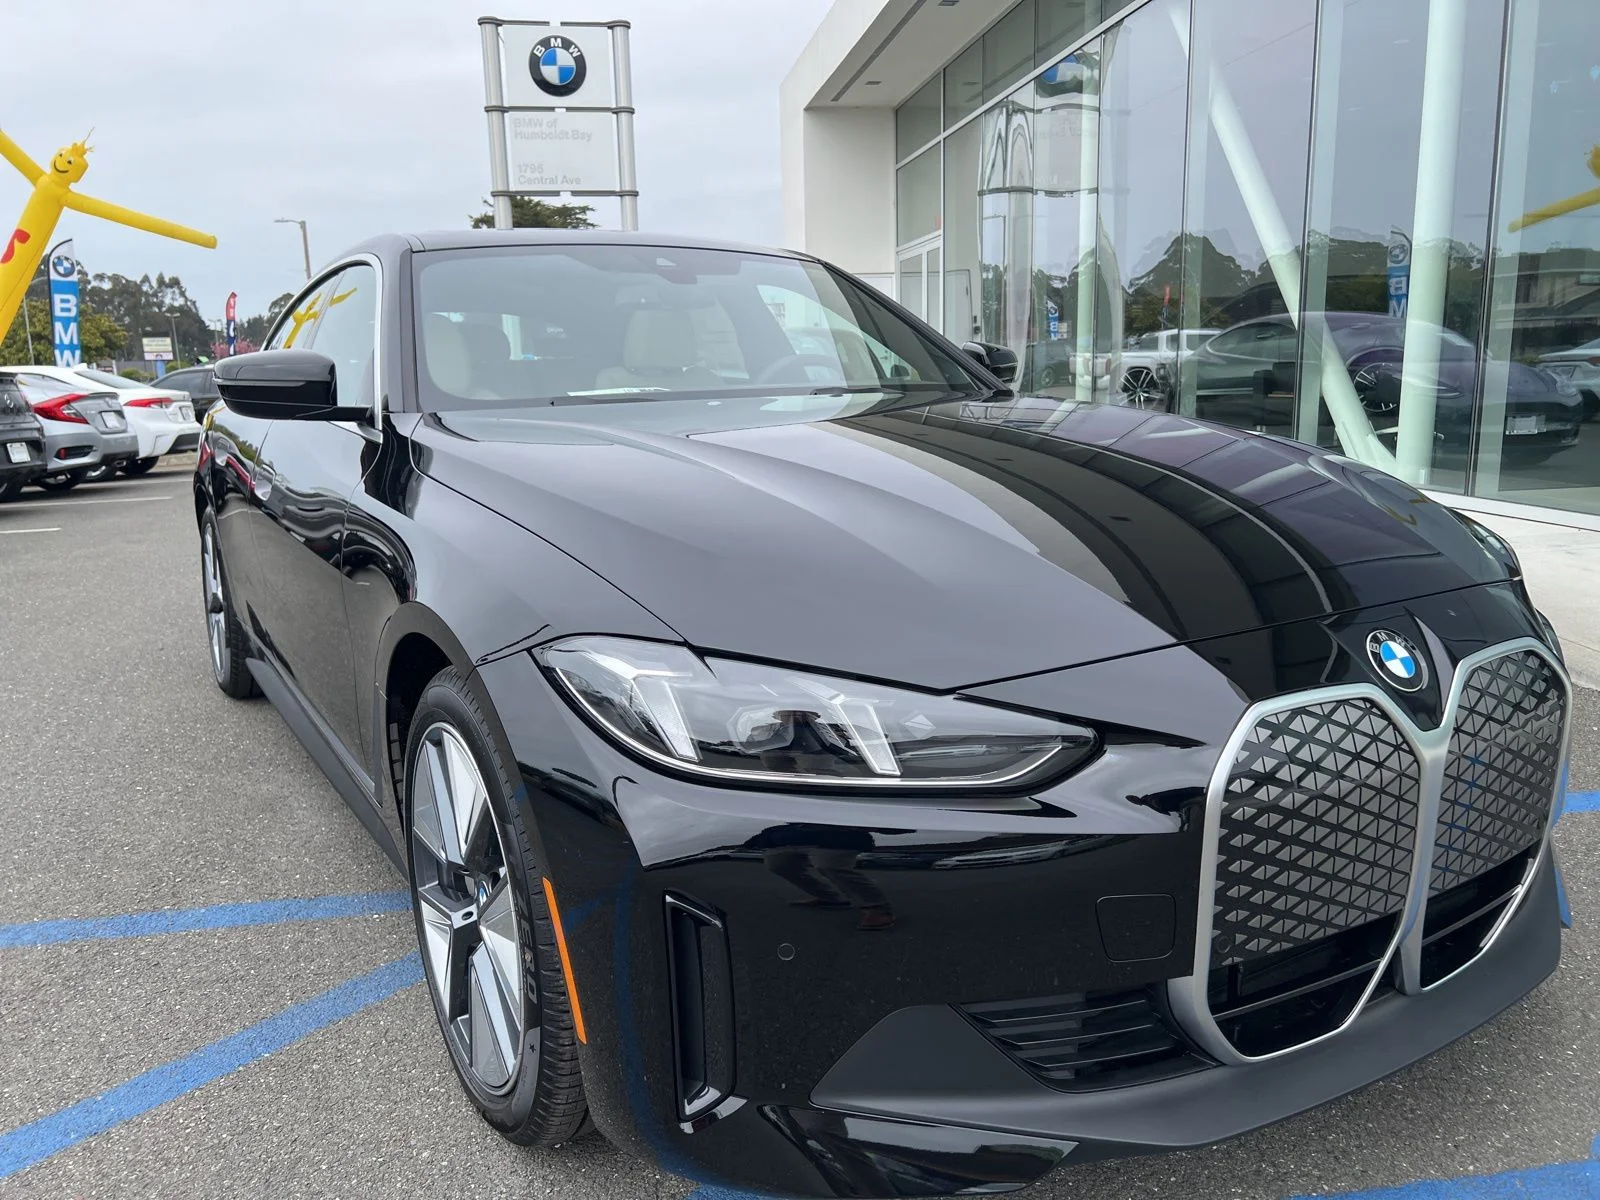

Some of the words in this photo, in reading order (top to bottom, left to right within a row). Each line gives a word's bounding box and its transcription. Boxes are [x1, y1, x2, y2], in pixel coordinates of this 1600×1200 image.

[533, 37, 581, 58] BMW
[514, 118, 543, 128] BMW
[546, 117, 559, 128] of
[514, 129, 570, 140] Humboldt
[571, 130, 593, 142] Bay
[518, 175, 558, 185] Central
[560, 175, 582, 185] Ave
[53, 293, 81, 367] BMW
[1369, 632, 1405, 653] BMW
[515, 888, 538, 1005] ZERO
